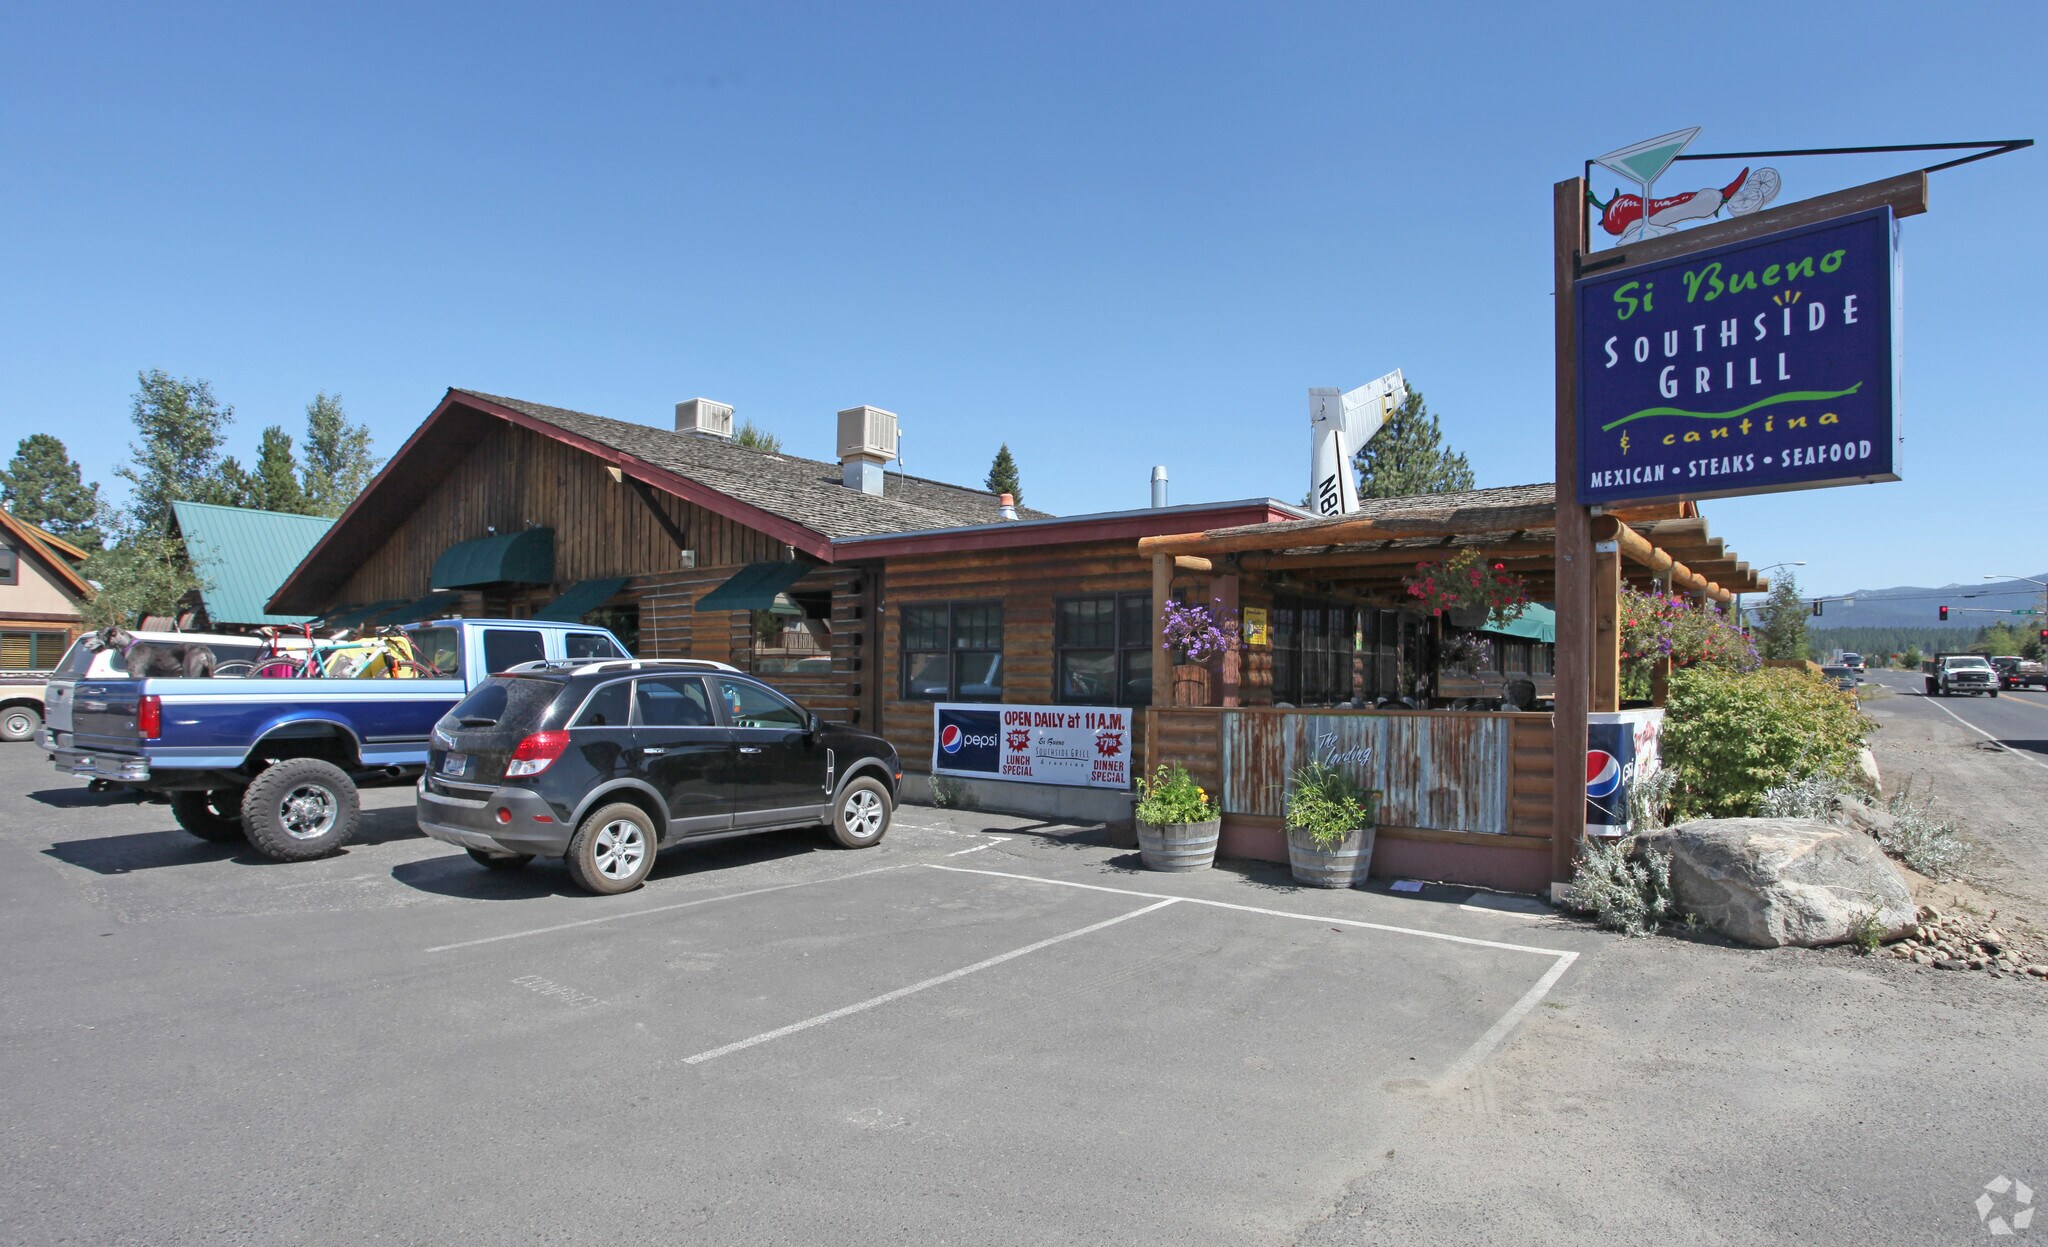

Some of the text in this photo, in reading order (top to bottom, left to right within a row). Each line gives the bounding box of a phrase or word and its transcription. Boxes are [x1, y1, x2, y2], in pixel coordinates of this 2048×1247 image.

[1613, 249, 1847, 321] Si Bueno
[1604, 294, 1858, 369] SOUTHSIDE
[1659, 352, 1791, 399] GRILL
[1662, 412, 1839, 446] cantina
[1591, 439, 1872, 489] MEXICAN STEAKS SEAFOOD
[1004, 711, 1032, 727] OPEN
[1034, 712, 1065, 728] DAILY
[1067, 712, 1081, 729] at
[964, 733, 998, 749] pepsi
[1319, 731, 1338, 749] The
[1006, 755, 1031, 765] LUNCH
[1035, 746, 1090, 759] SOUTHSIDE GRILL
[1002, 765, 1033, 777] SPECIAL
[1093, 760, 1124, 771] DINNER
[1091, 771, 1126, 783] SPECIAL
